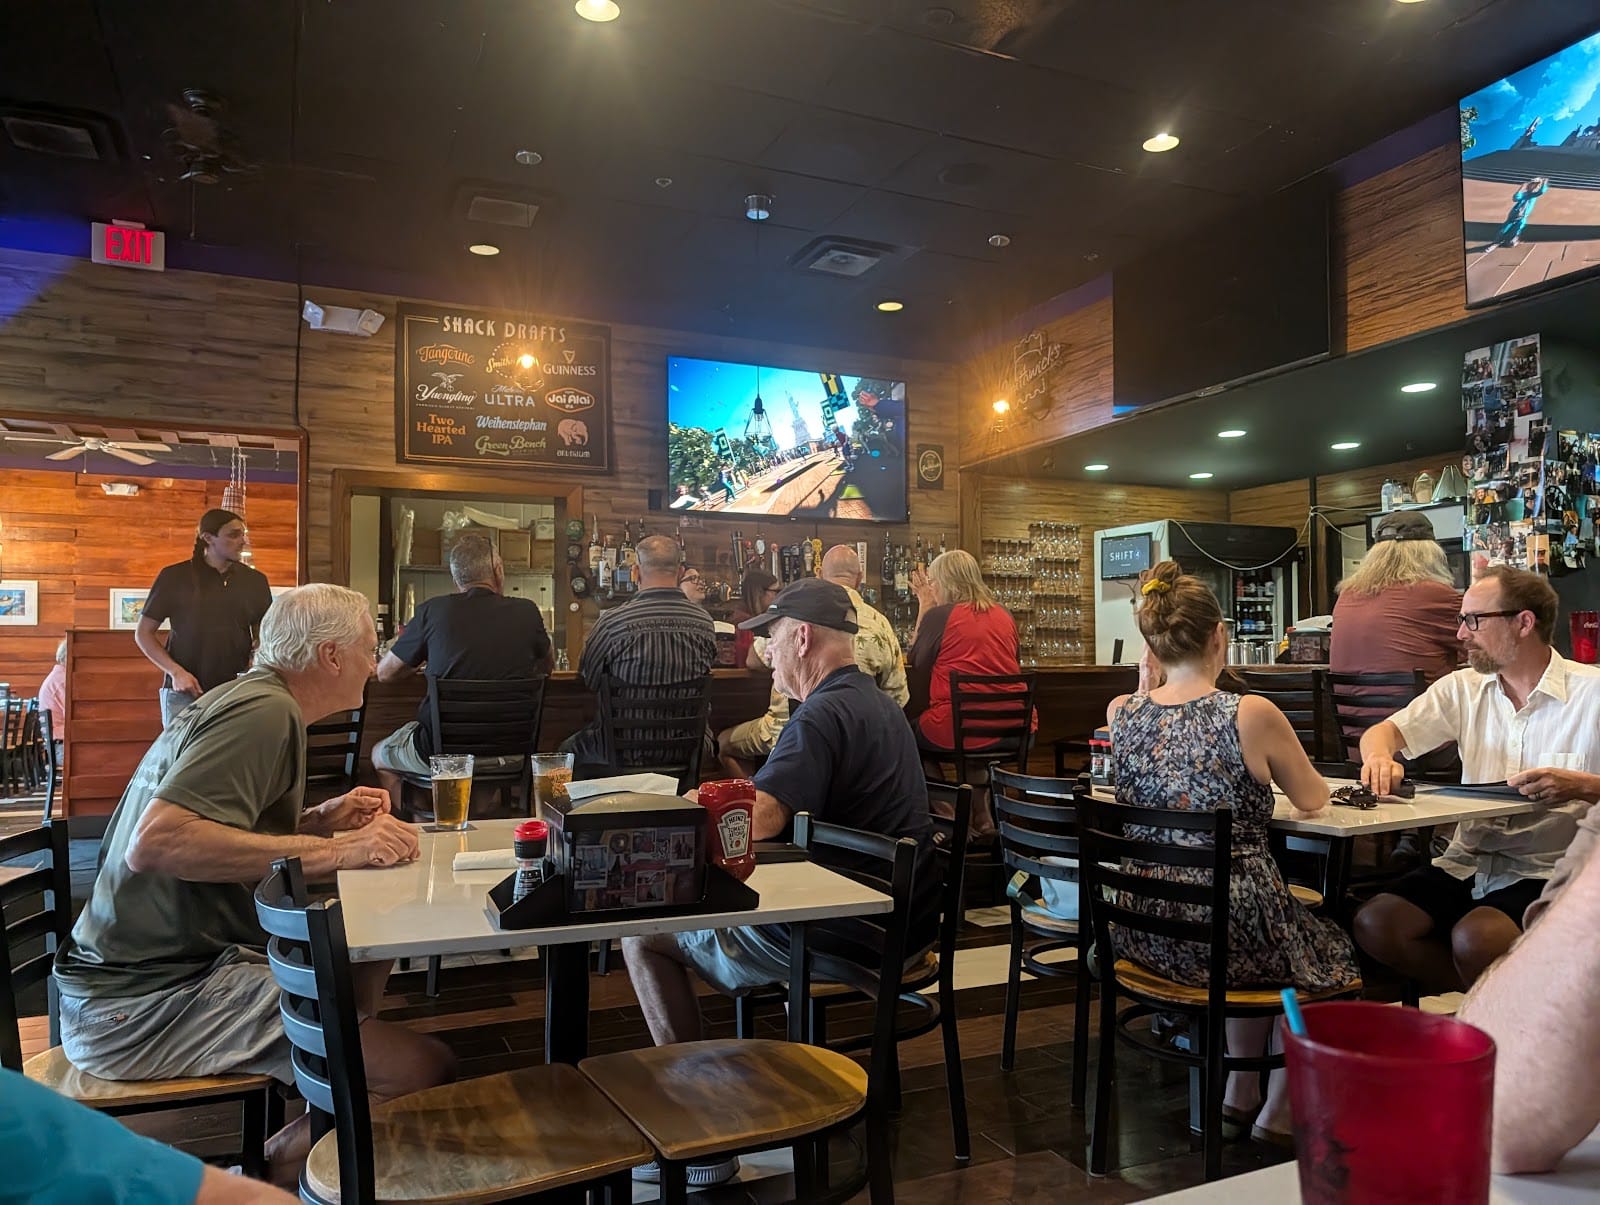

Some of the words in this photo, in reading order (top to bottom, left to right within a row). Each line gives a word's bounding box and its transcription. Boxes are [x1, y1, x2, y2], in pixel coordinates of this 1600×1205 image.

[105, 226, 155, 265] EXIT
[442, 315, 496, 336] SHACK
[504, 322, 566, 343] DRAFTS
[415, 343, 476, 367] Tangerine
[542, 363, 597, 376] GUINNESS
[415, 383, 478, 406] Yuengling
[484, 393, 535, 407] ULTRA
[548, 394, 566, 404] Jai
[567, 395, 591, 405] Alai
[428, 413, 455, 426] Two
[475, 415, 548, 432] Weihenstephan
[416, 421, 466, 436] Hearted
[432, 434, 453, 445] IPA
[474, 435, 510, 456] Green
[509, 436, 547, 449] Bench
[728, 815, 744, 824] HEINZ
